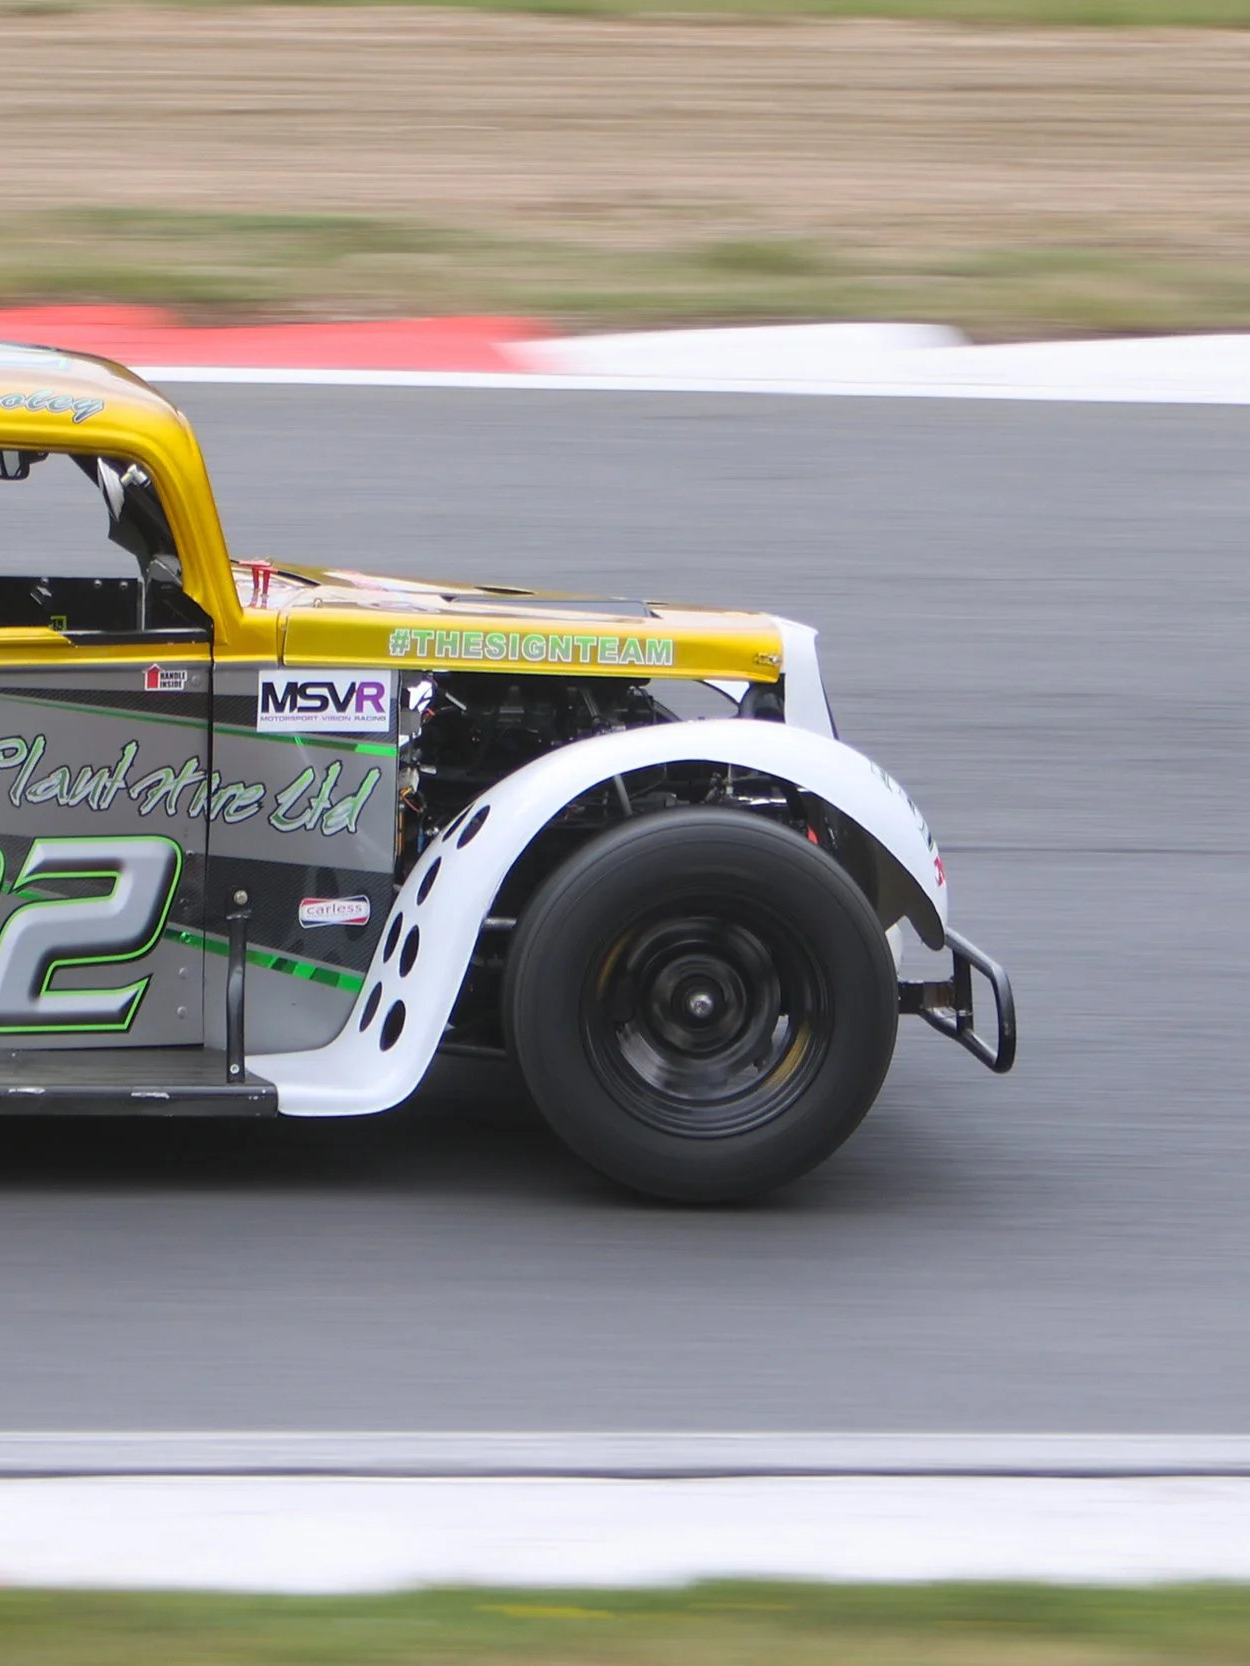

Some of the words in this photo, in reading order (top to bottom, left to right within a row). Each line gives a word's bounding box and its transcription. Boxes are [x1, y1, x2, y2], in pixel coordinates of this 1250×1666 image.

[389, 628, 674, 666] #THESIGNTEAM
[160, 671, 186, 680] HANDLE
[160, 680, 182, 688] INSIDE
[261, 681, 386, 713] MSVR
[129, 756, 265, 823] Hire
[268, 760, 381, 836] Ltd
[306, 903, 363, 916] carless
